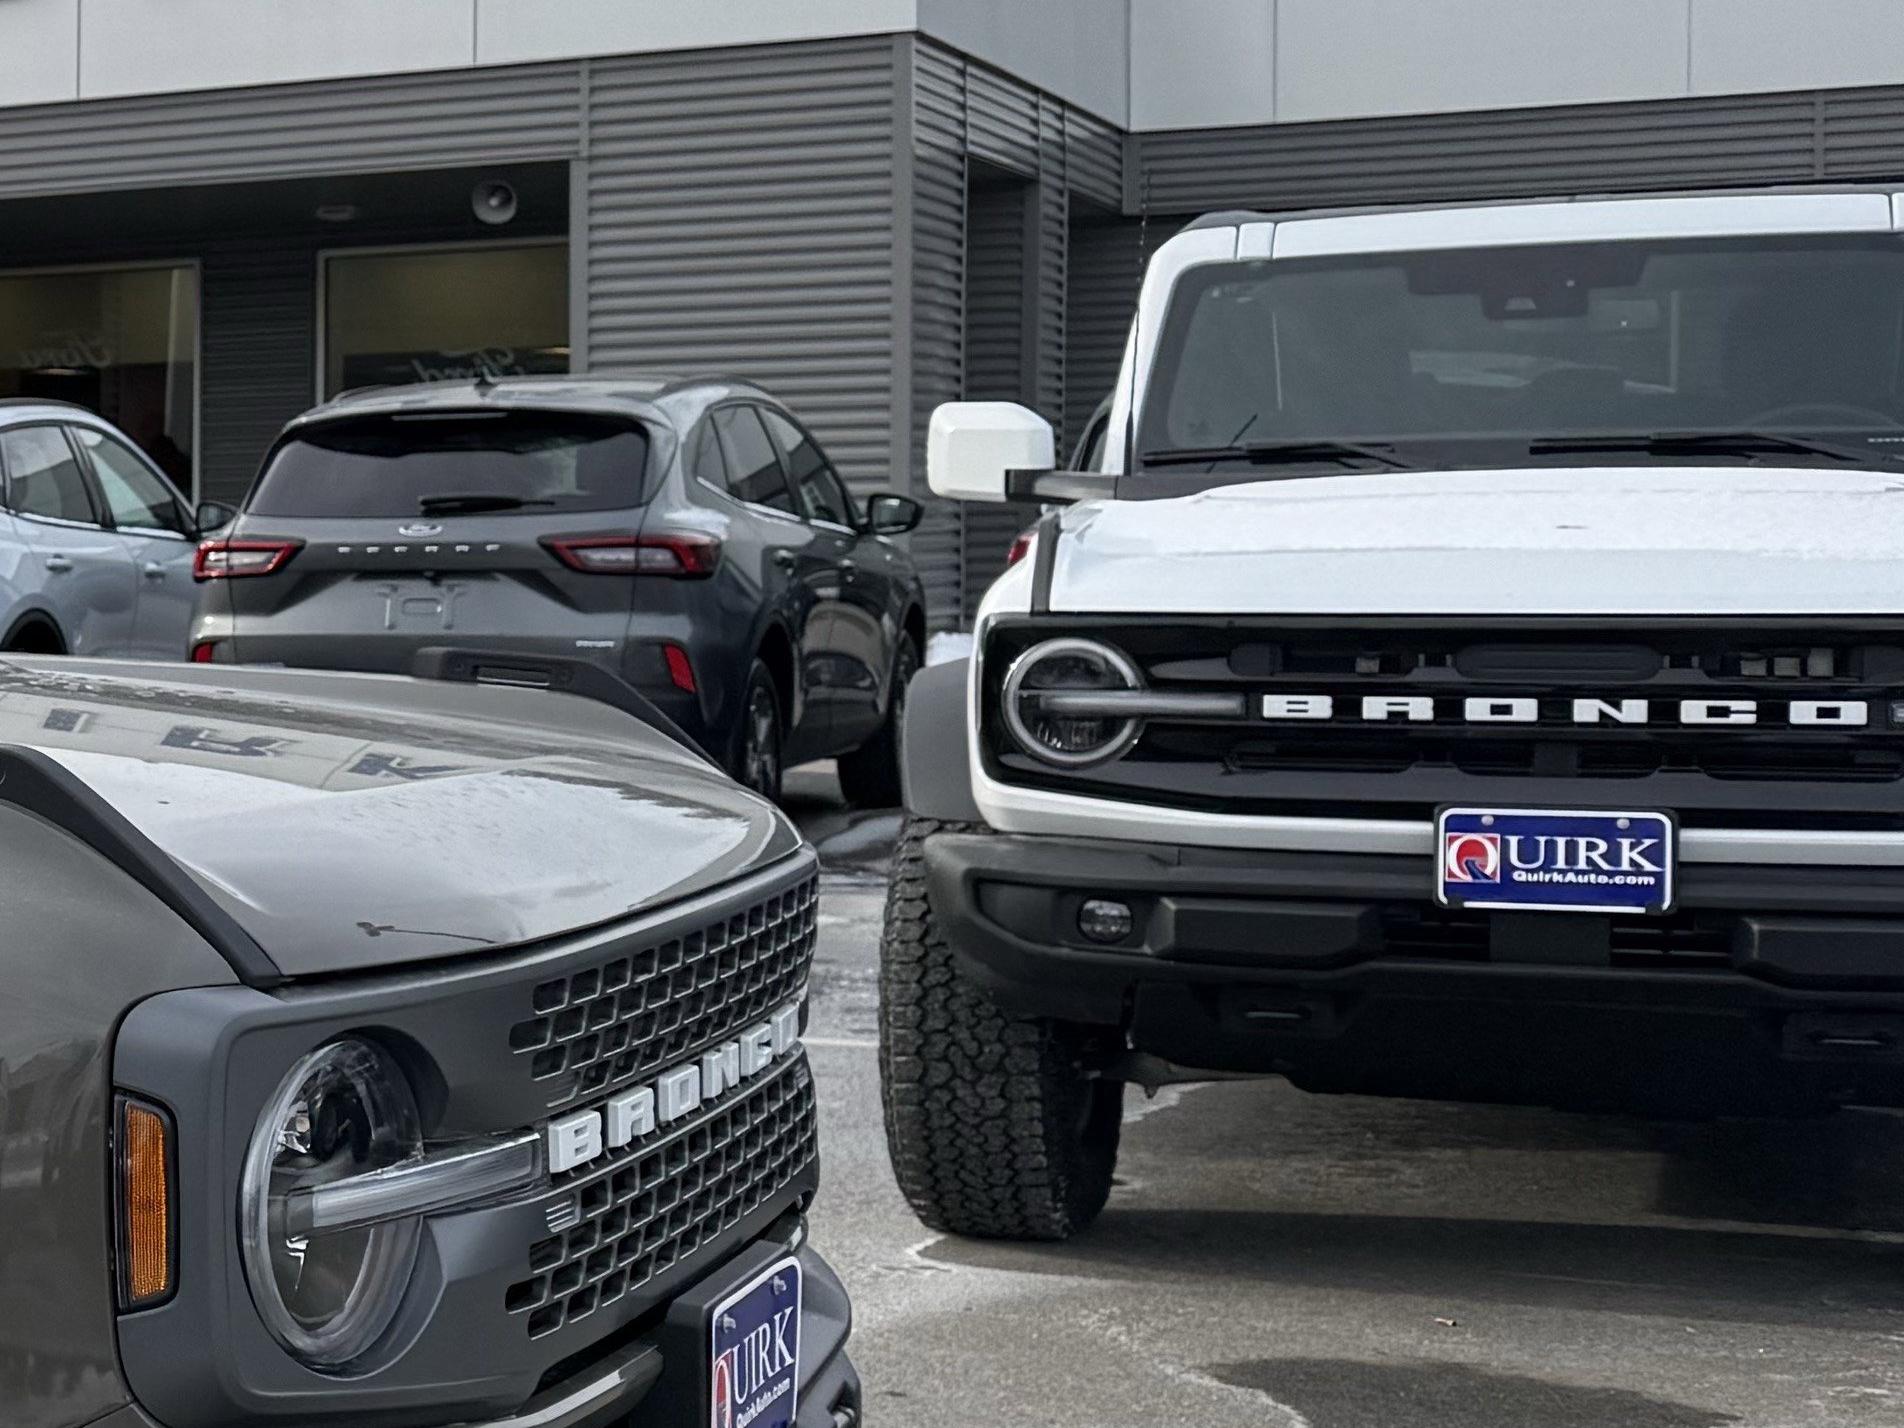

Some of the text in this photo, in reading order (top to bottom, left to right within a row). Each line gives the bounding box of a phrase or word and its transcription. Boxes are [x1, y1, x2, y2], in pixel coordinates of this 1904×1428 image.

[1262, 694, 1868, 725] BRONCO
[1446, 833, 1664, 882] QUIRK
[1512, 870, 1656, 886] QuirkAuto.com
[548, 1001, 800, 1173] BRONCO
